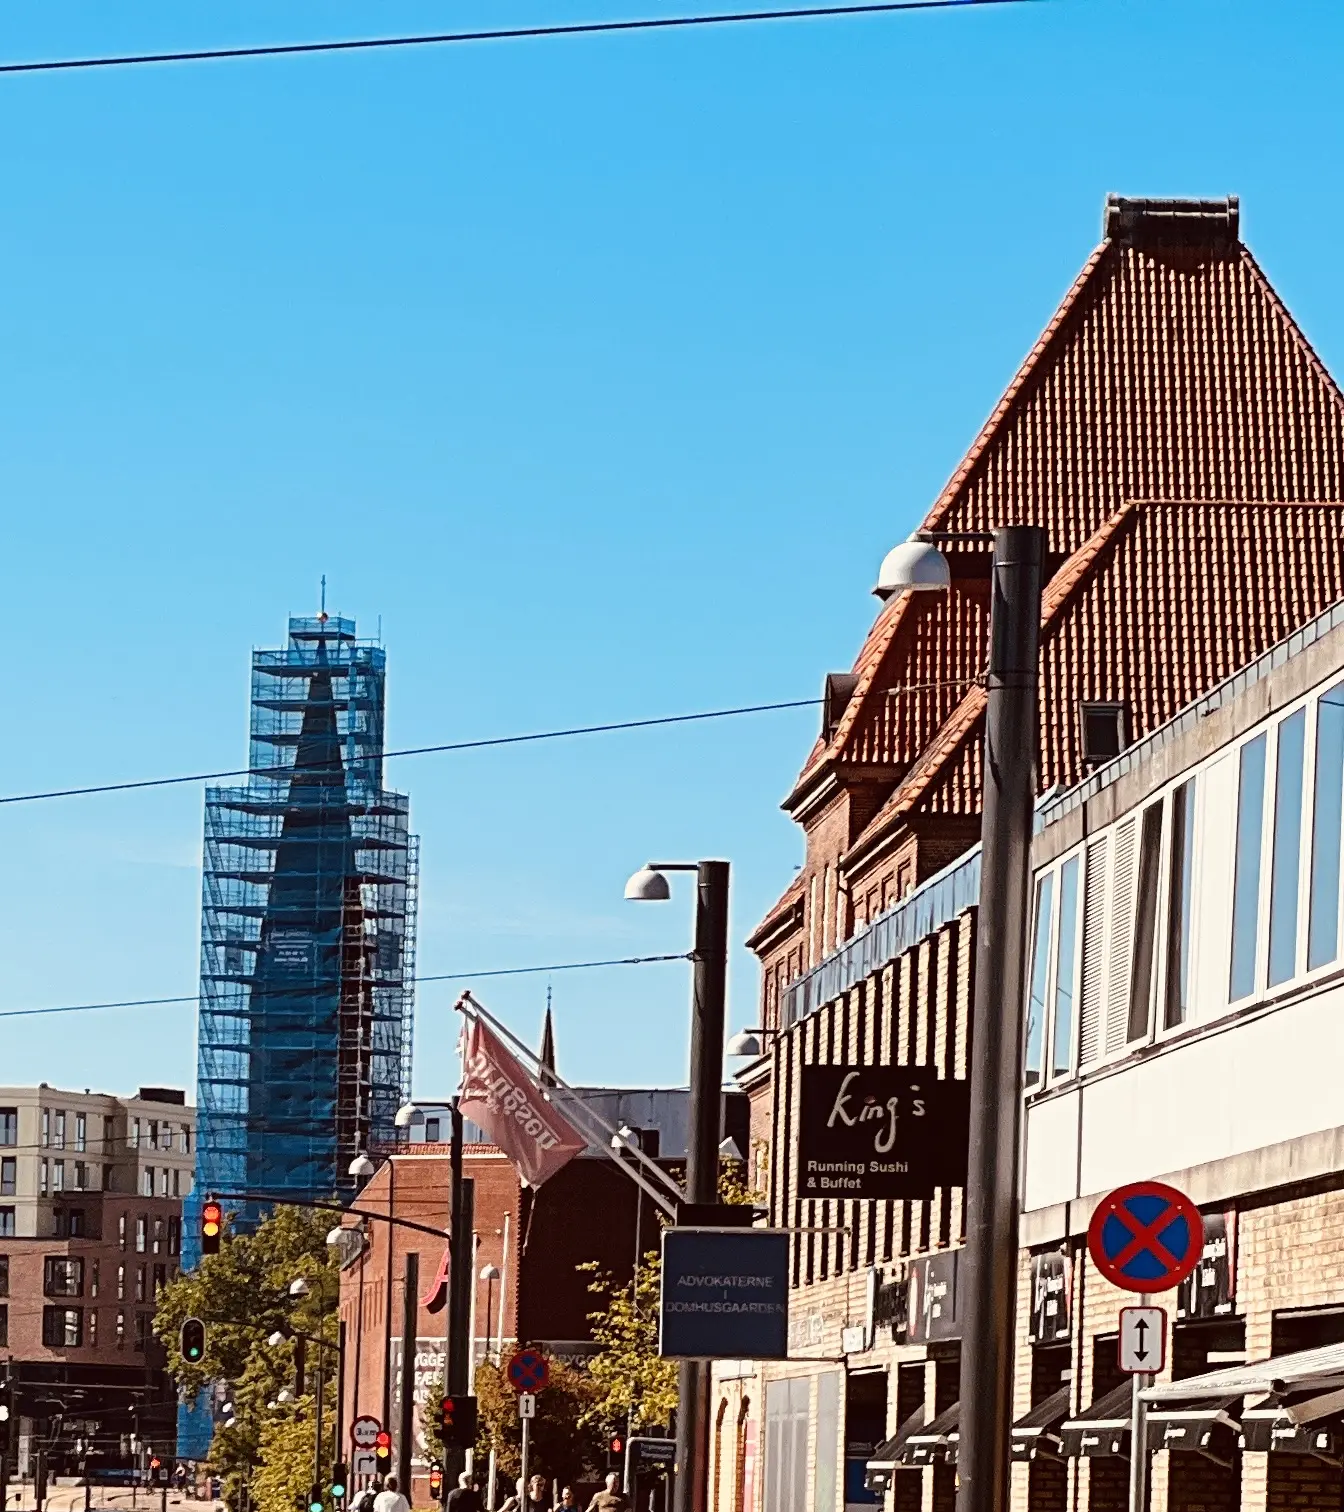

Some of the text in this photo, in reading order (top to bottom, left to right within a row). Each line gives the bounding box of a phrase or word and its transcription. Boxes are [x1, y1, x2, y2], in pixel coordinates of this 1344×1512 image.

[807, 1160, 909, 1174] Running Sushi
[806, 1176, 862, 1189] & Buffet
[677, 1276, 775, 1288] ADVOKATERNE
[665, 1302, 785, 1314] DOMHUSGAARDEN
